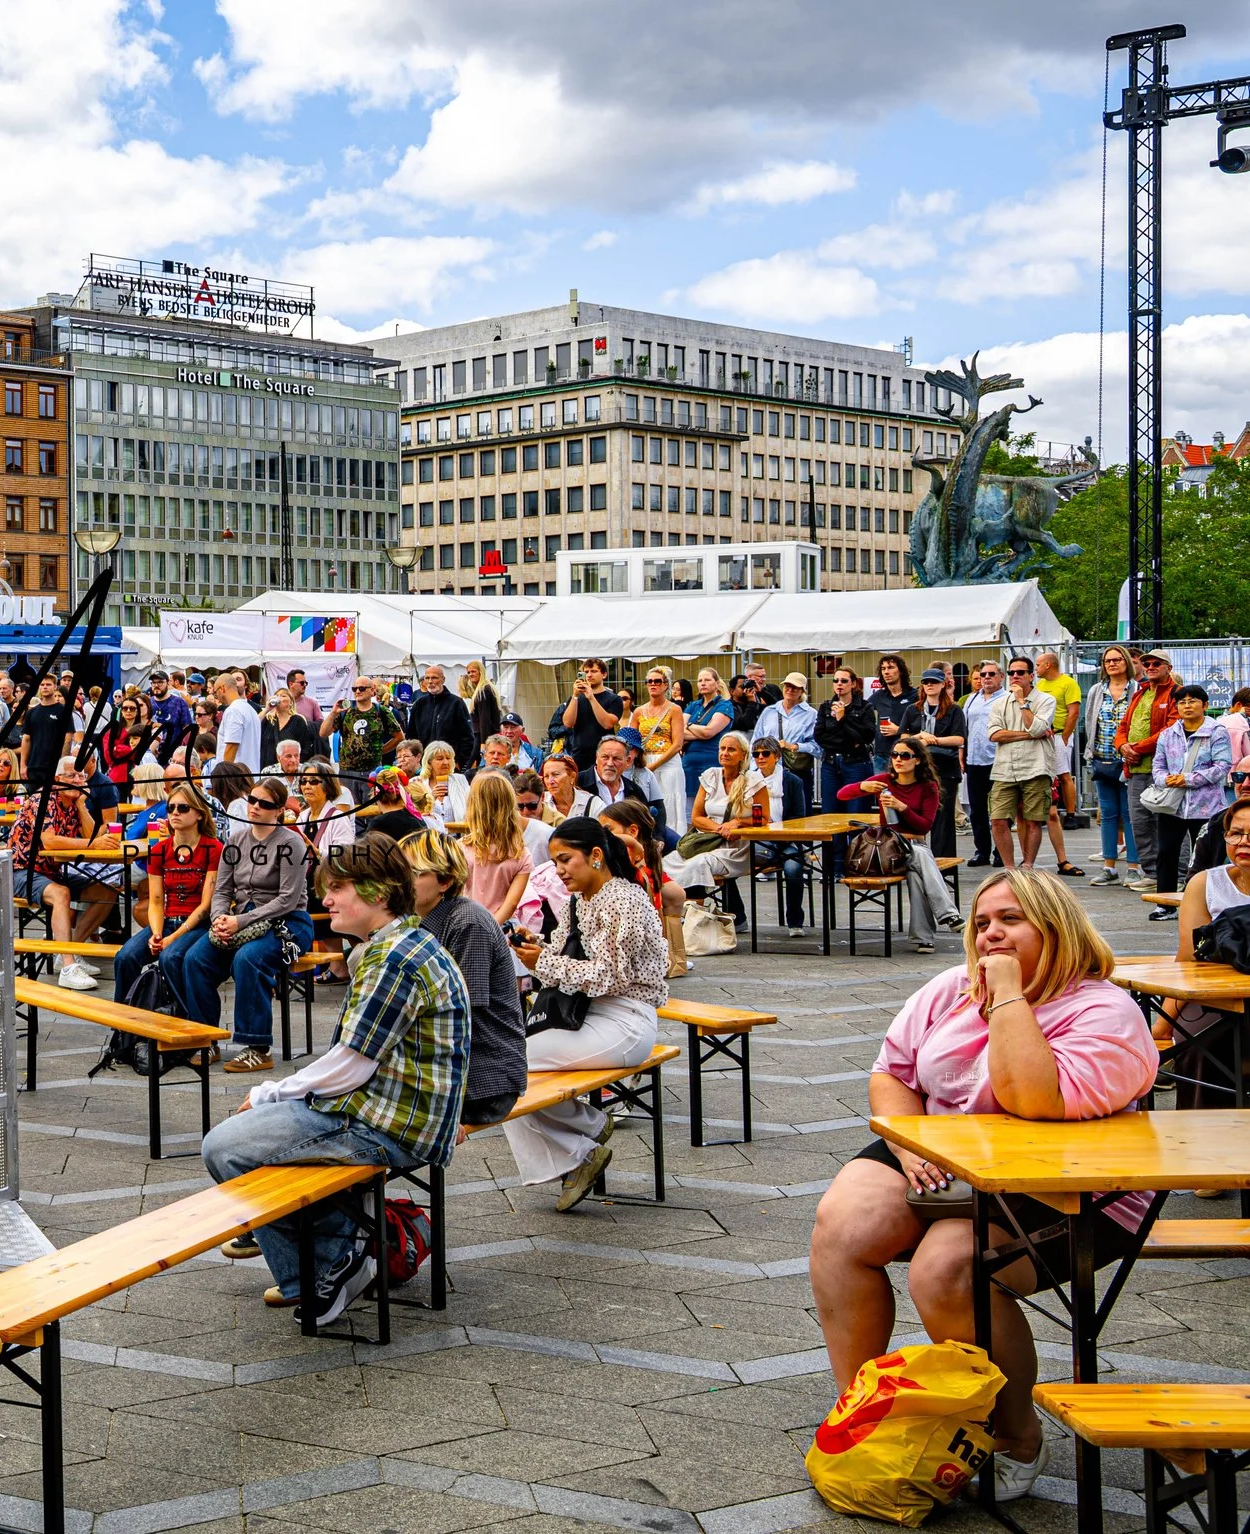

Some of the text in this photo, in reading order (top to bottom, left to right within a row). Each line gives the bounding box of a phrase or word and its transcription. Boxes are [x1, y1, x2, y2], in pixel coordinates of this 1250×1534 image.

[174, 262, 249, 285] The Square
[117, 294, 290, 328] BYENS BEDSTE BELIGGENHEDER
[216, 289, 265, 308] HOTEL
[267, 297, 316, 317] GROUP
[177, 367, 316, 397] Hotel The Square
[132, 594, 175, 605] The Square
[187, 619, 214, 635] kafe
